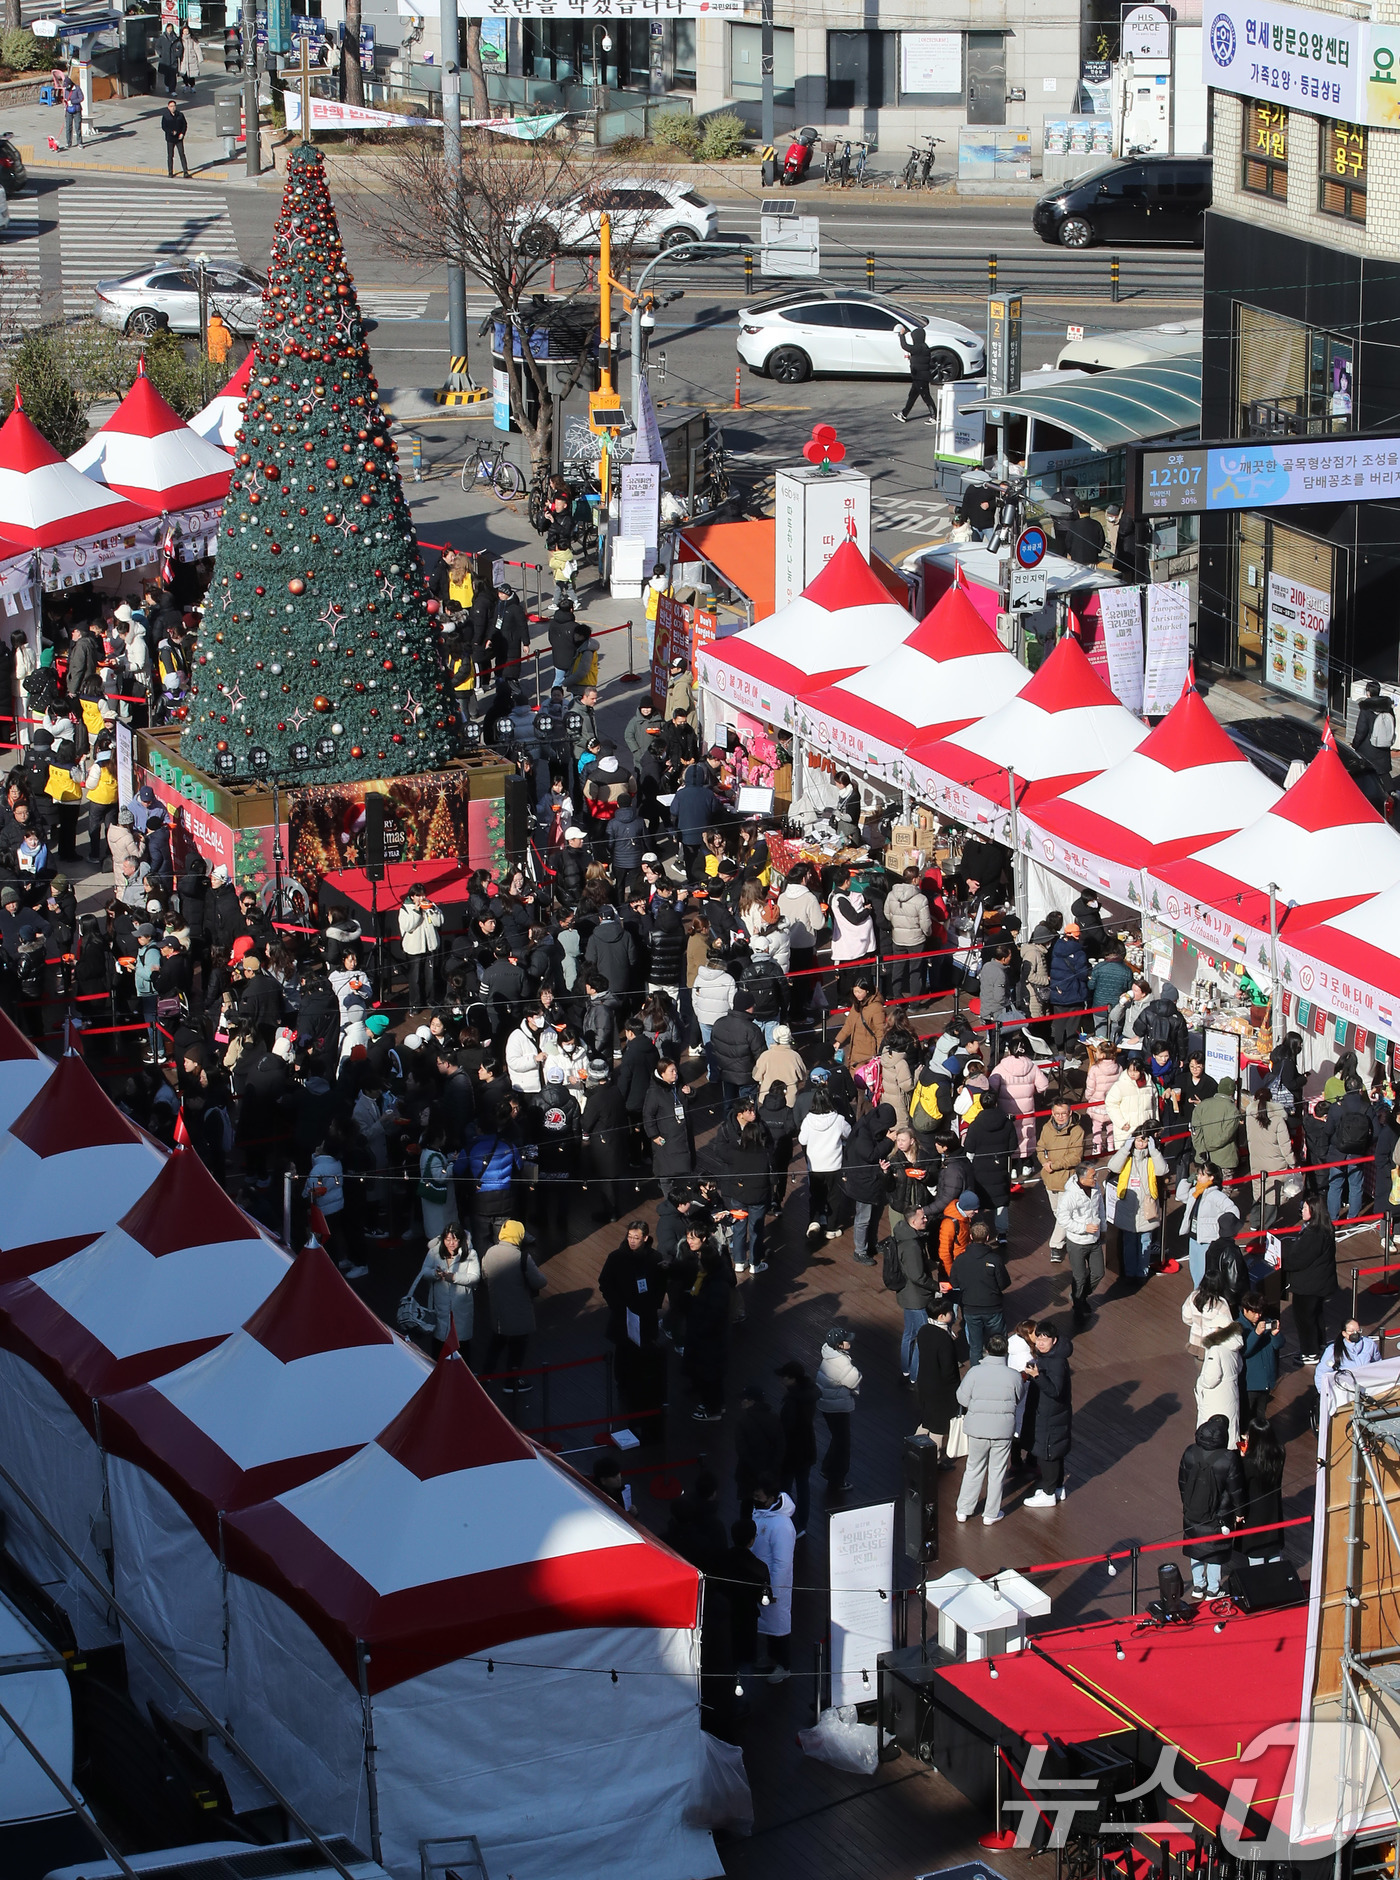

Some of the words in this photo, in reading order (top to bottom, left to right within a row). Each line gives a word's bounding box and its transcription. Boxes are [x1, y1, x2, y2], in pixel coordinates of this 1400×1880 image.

[1131, 23, 1160, 32] PLACE
[1370, 47, 1400, 84] 요
[313, 104, 344, 119] 탄핵
[1257, 101, 1286, 131] 국가
[1257, 129, 1285, 160] 지원
[1334, 147, 1364, 178] 용구
[994, 322, 1001, 333] 2
[1167, 454, 1185, 465] 오후
[1239, 460, 1277, 475] 깨끗한
[1283, 454, 1357, 472] 골목형상점가
[1362, 452, 1399, 467] 조성을
[1149, 466, 1202, 487] 12:07
[1303, 472, 1365, 490] 담배꽁초를
[1153, 498, 1168, 507] 보통
[1180, 496, 1197, 506] 30%
[98, 551, 116, 562] Spain
[1021, 542, 1042, 553] 주차금지
[1014, 573, 1045, 584] 견인지역
[1290, 587, 1306, 607] 리아
[729, 673, 758, 699] 불가리아
[733, 690, 754, 708] Bulgaria
[832, 726, 864, 752] 불가리아
[837, 743, 860, 760] Bulgaria
[944, 786, 970, 808] 폴란드
[948, 801, 967, 818] Poland
[193, 818, 224, 855] 크리스마스
[1063, 848, 1089, 870] 폴란드
[1065, 863, 1088, 880] Poland
[1183, 901, 1232, 938] 리투아니아
[1190, 922, 1220, 946] Lithuania
[1319, 971, 1374, 1010] 크로아티아
[1331, 995, 1360, 1017] Croatia
[1207, 1050, 1235, 1062] BUREK
